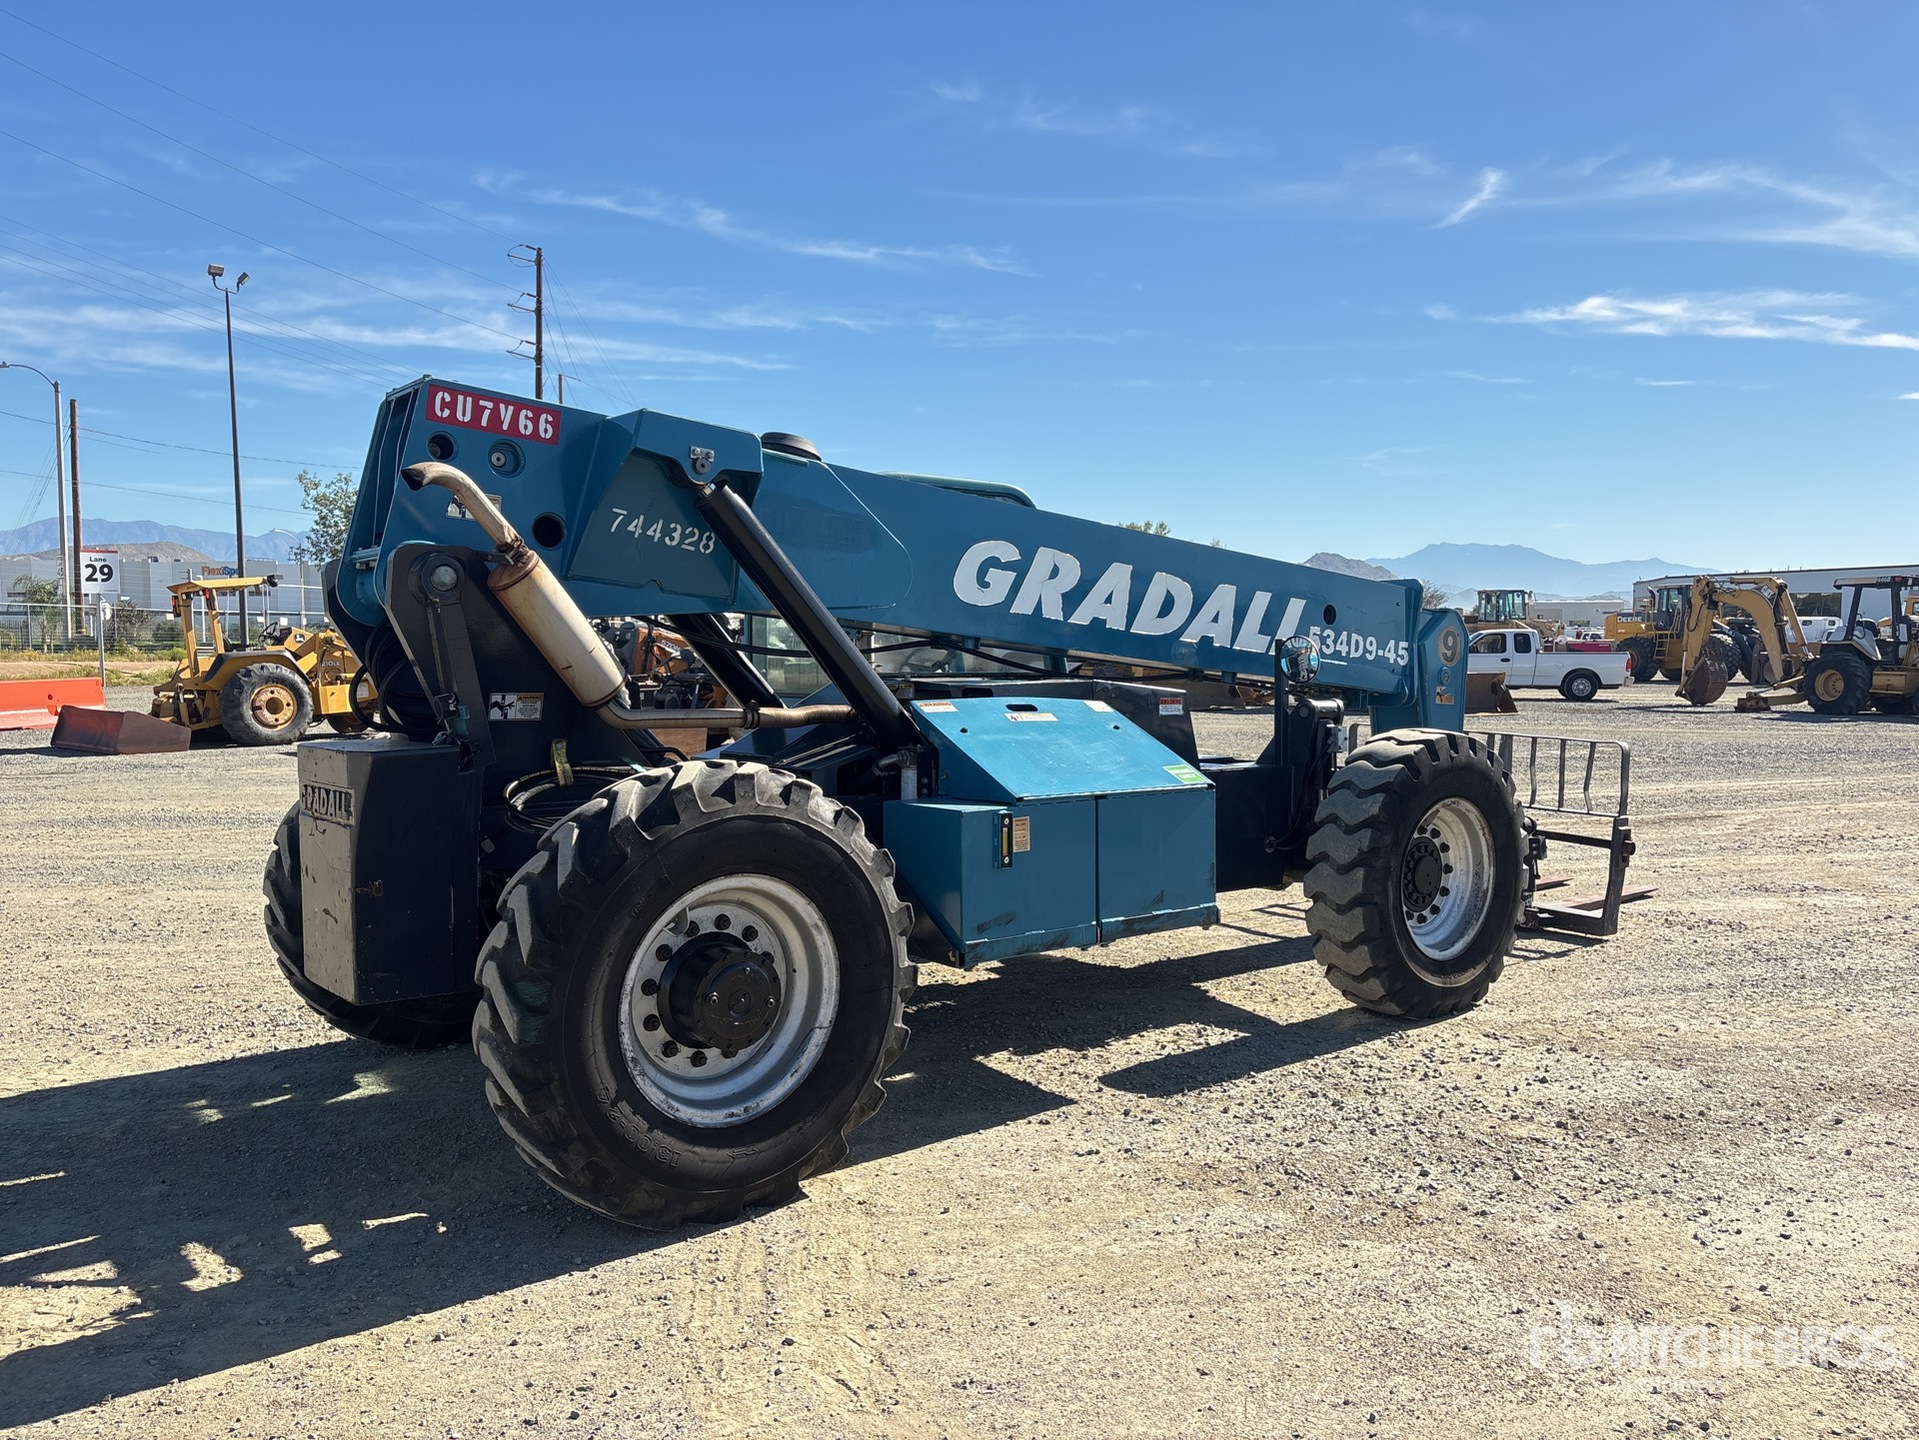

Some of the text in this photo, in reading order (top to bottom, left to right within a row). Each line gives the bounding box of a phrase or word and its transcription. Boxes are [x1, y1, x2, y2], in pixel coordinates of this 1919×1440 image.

[610, 507, 716, 554] 744328
[84, 563, 114, 583] 29
[201, 565, 240, 578] FlexiSpo
[953, 539, 1307, 656] GRADALL
[1308, 626, 1410, 667] 534D9-45
[594, 1083, 683, 1169] 13.00-24
